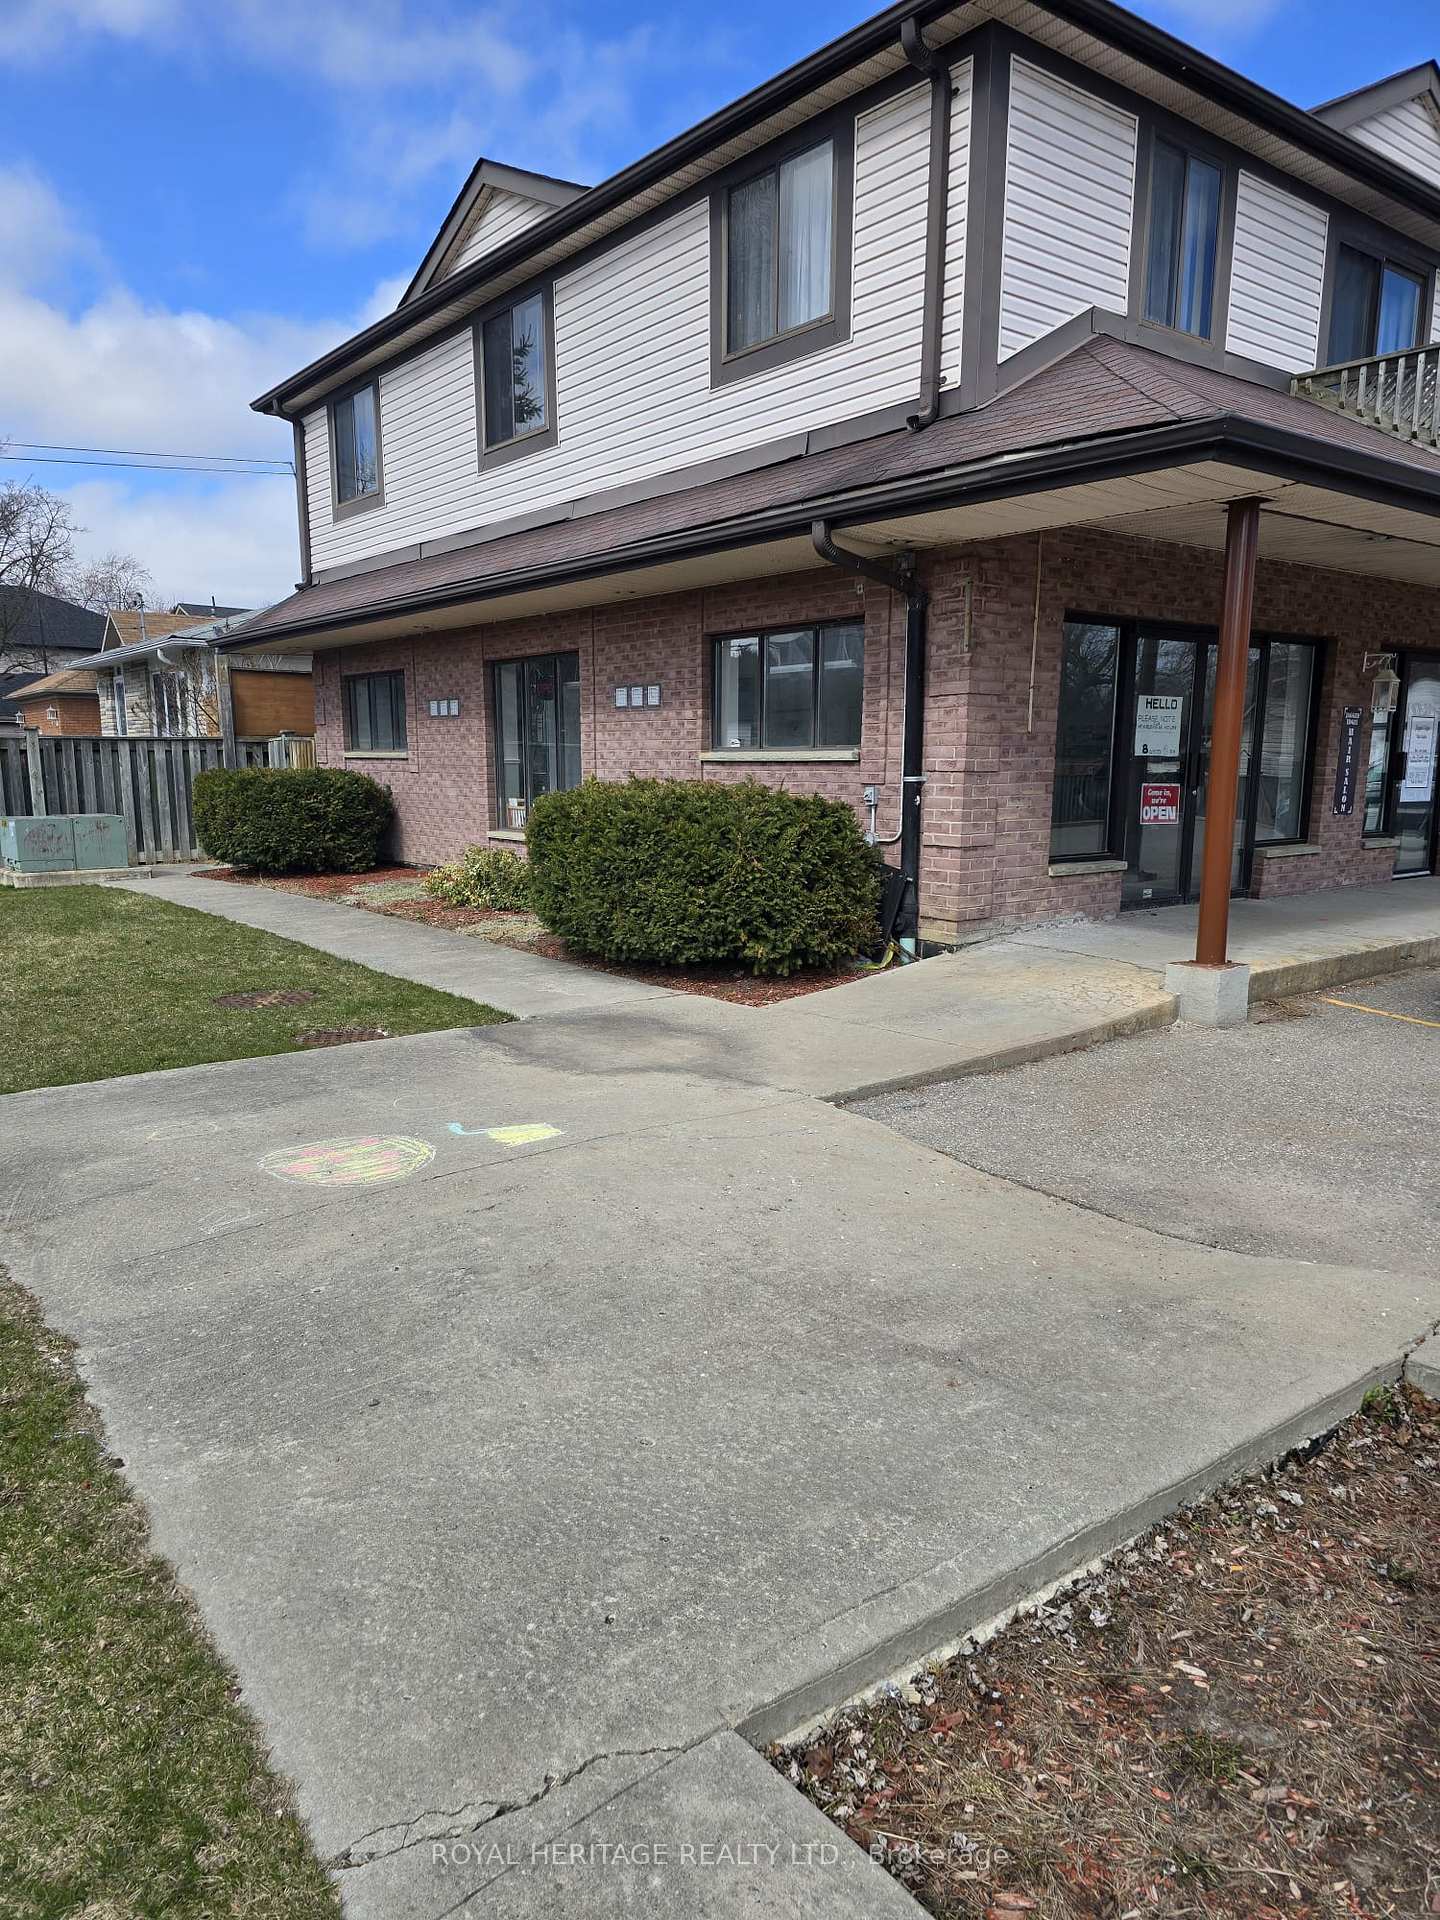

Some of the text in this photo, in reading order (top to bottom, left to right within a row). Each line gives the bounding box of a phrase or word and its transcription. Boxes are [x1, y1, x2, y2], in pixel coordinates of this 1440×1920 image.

[1145, 698, 1178, 710] HELLO
[1142, 743, 1149, 754] 8
[1345, 728, 1354, 763] HAIR
[1147, 788, 1162, 797] Come
[1340, 768, 1349, 812] SALON
[1143, 806, 1176, 820] OPEN
